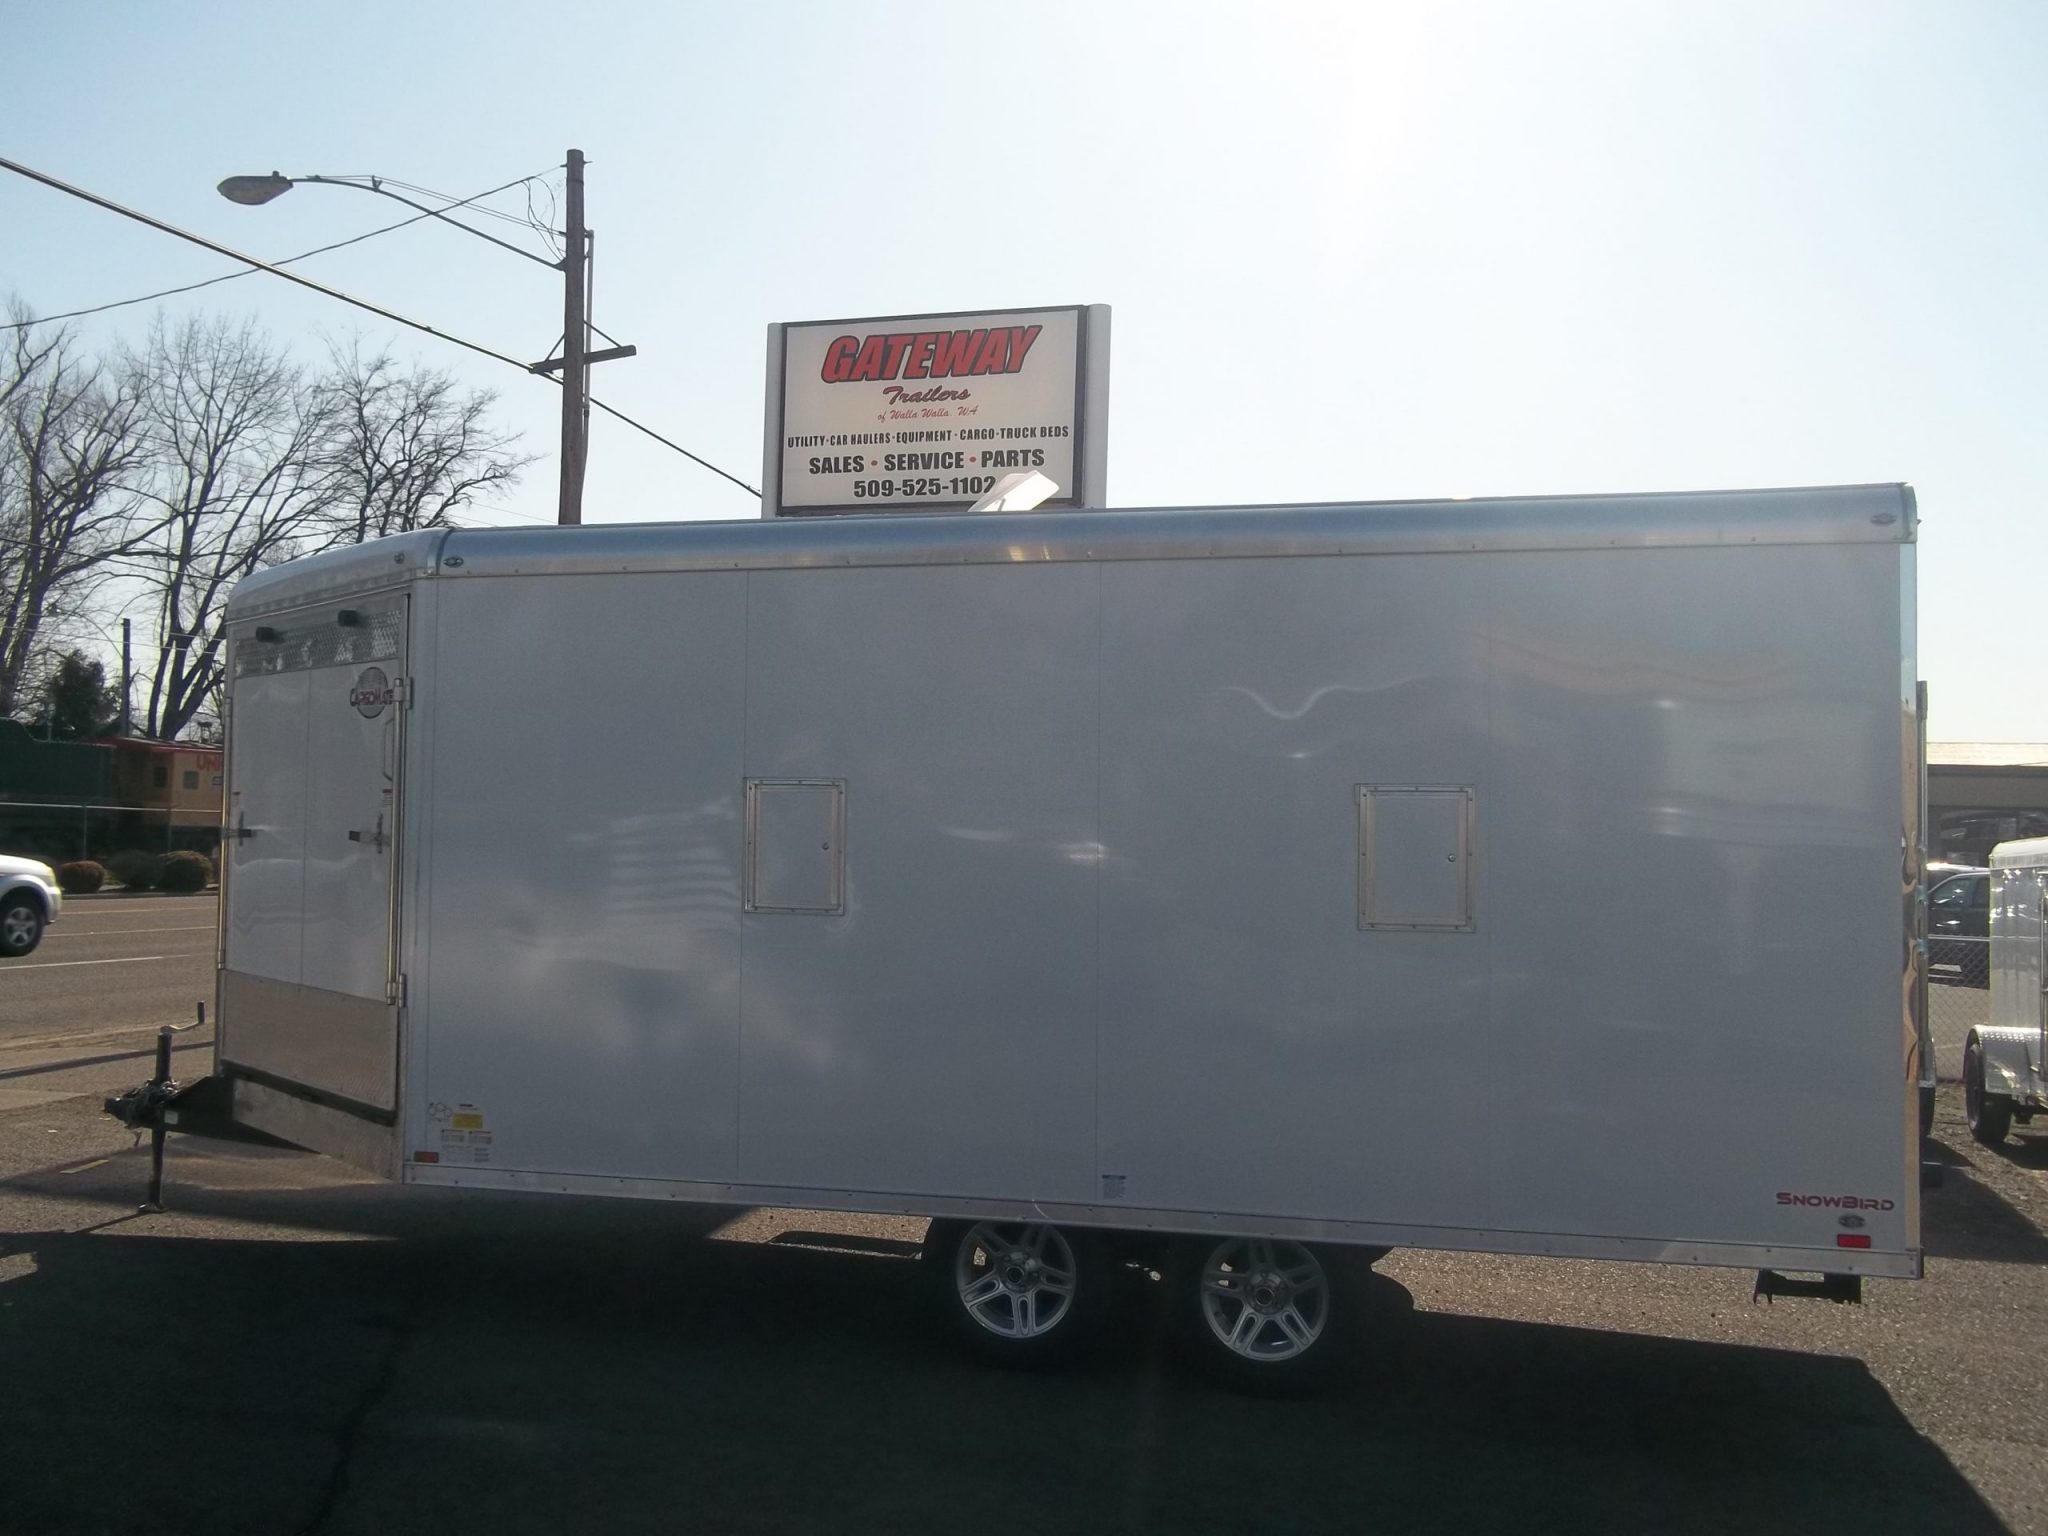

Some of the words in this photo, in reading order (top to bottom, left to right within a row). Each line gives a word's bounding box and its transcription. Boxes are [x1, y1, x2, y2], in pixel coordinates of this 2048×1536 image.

[821, 325, 1042, 383] GATEWAY
[883, 385, 971, 405] Trailers
[878, 411, 886, 423] of
[890, 409, 917, 419] Walla
[957, 405, 979, 416] WA
[788, 435, 825, 448] UTILITY
[830, 435, 848, 446] CAR
[851, 432, 891, 445] HAULERS
[896, 430, 952, 443] EQUIPMENT
[960, 428, 995, 440] CARGO
[1000, 427, 1037, 439] TRUCK
[1040, 426, 1069, 438] BEDS
[809, 455, 865, 474] SALES
[884, 452, 965, 471] SERVICE
[981, 448, 1045, 468] PARTS
[853, 475, 997, 498] 509-525-1102
